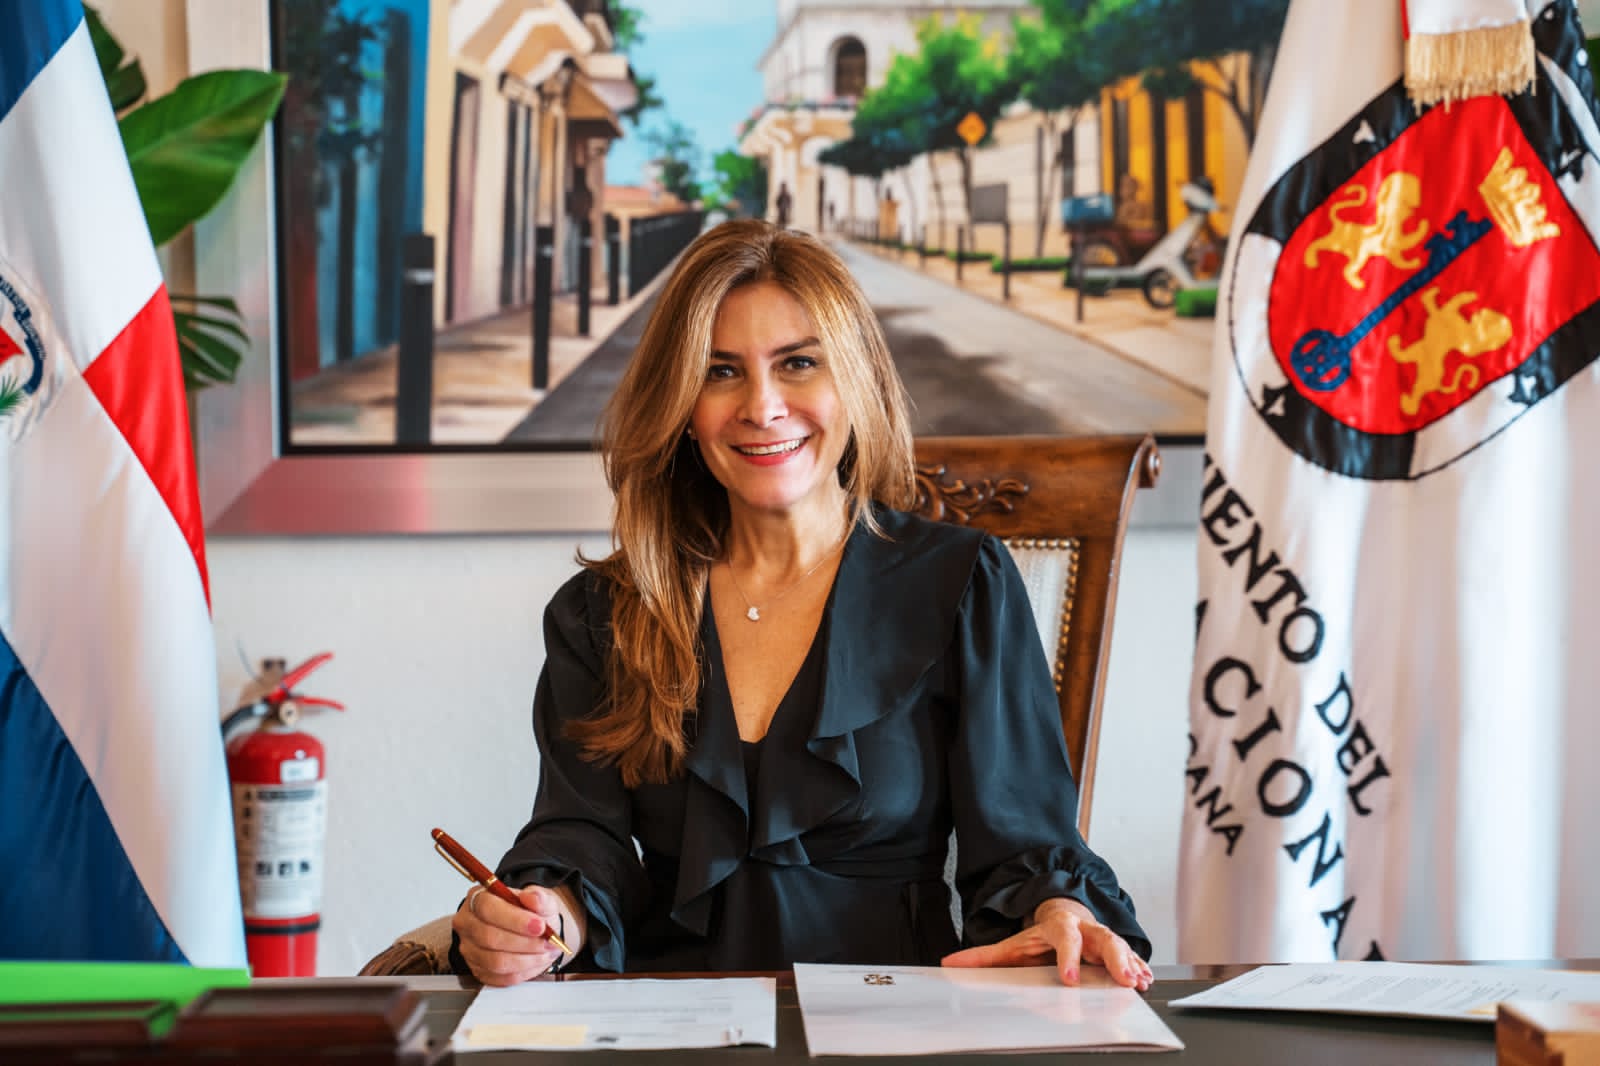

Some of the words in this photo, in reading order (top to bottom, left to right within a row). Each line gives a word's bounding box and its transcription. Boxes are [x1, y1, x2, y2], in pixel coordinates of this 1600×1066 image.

[1195, 599, 1386, 961] CIONA
[1201, 452, 1326, 664] IENTO
[1315, 671, 1391, 816] DEL
